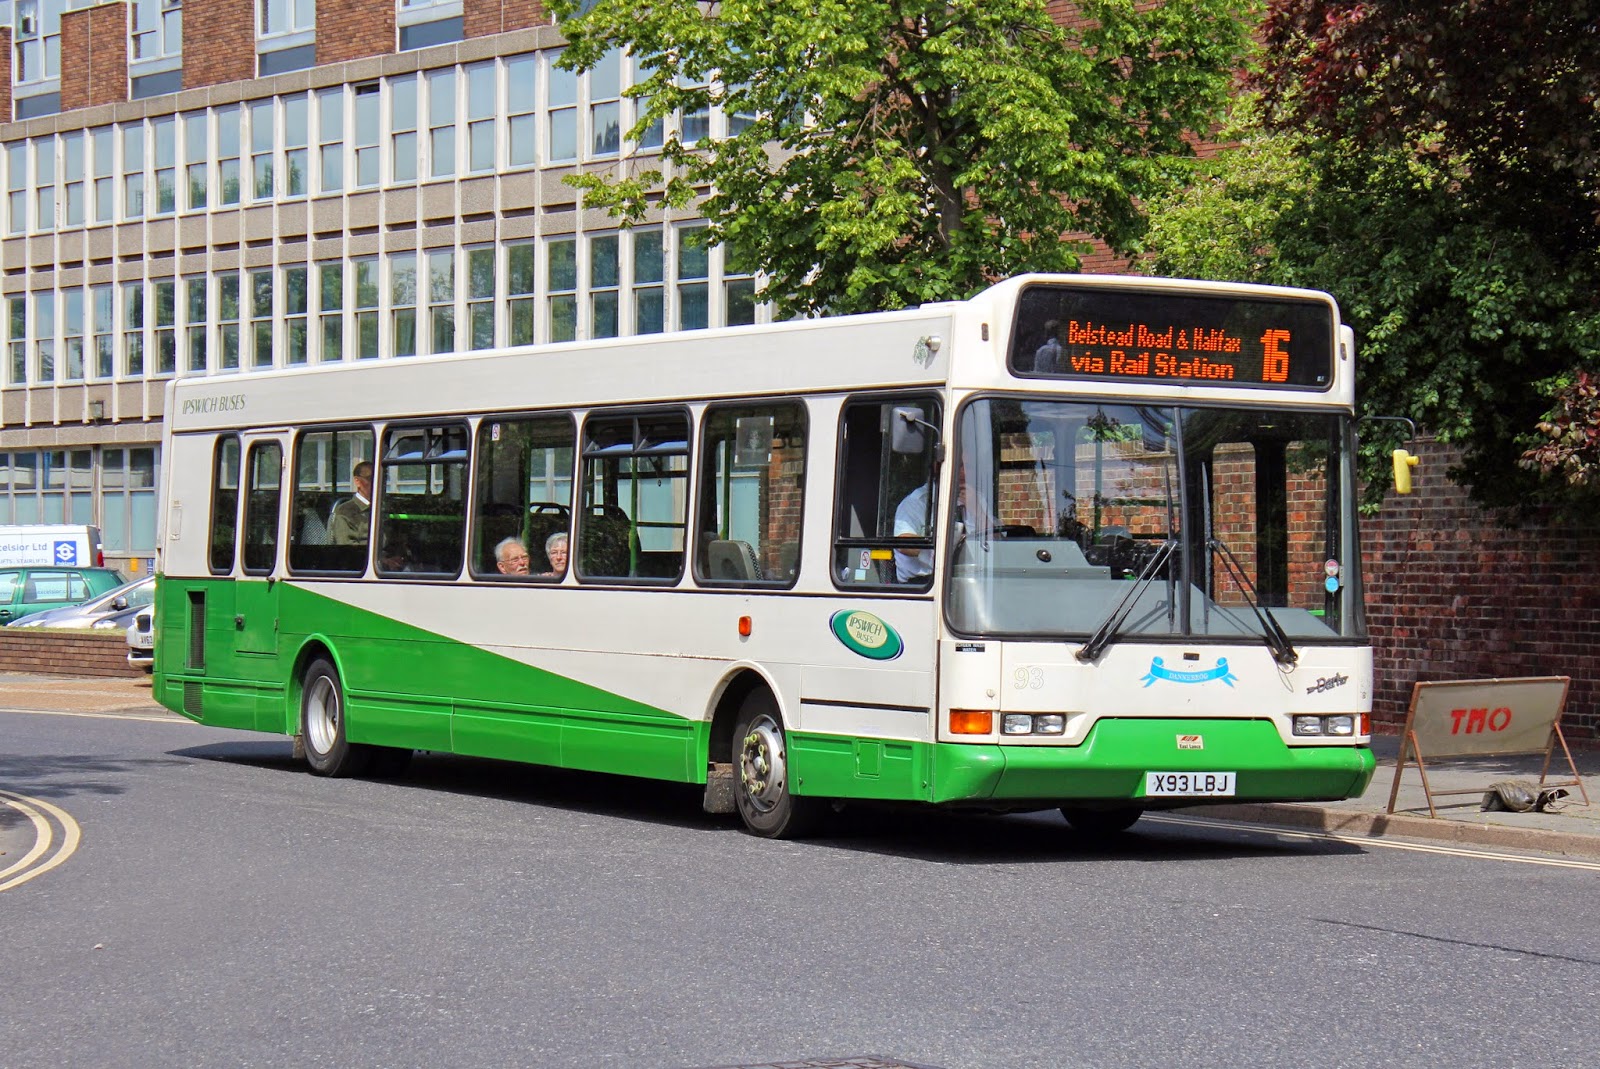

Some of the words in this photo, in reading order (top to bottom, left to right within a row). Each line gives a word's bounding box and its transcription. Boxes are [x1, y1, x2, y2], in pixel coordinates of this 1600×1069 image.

[1068, 320, 1135, 347] Belstead
[1137, 324, 1173, 349] Road
[1176, 329, 1189, 350] &
[1193, 327, 1241, 352] Halifax
[1071, 351, 1104, 373] via
[1110, 350, 1149, 375] Rail
[1154, 352, 1234, 379] Station
[1260, 329, 1291, 381] 16
[182, 396, 218, 415] IPSWICH
[218, 393, 247, 412] BUSES
[32, 543, 47, 551] Ltd
[849, 616, 882, 636] IPSWICH
[856, 630, 874, 644] BUSES
[1014, 667, 1045, 690] 93
[1451, 707, 1512, 735] TMO
[1155, 775, 1189, 792] X93
[1193, 775, 1228, 792] LBJ
